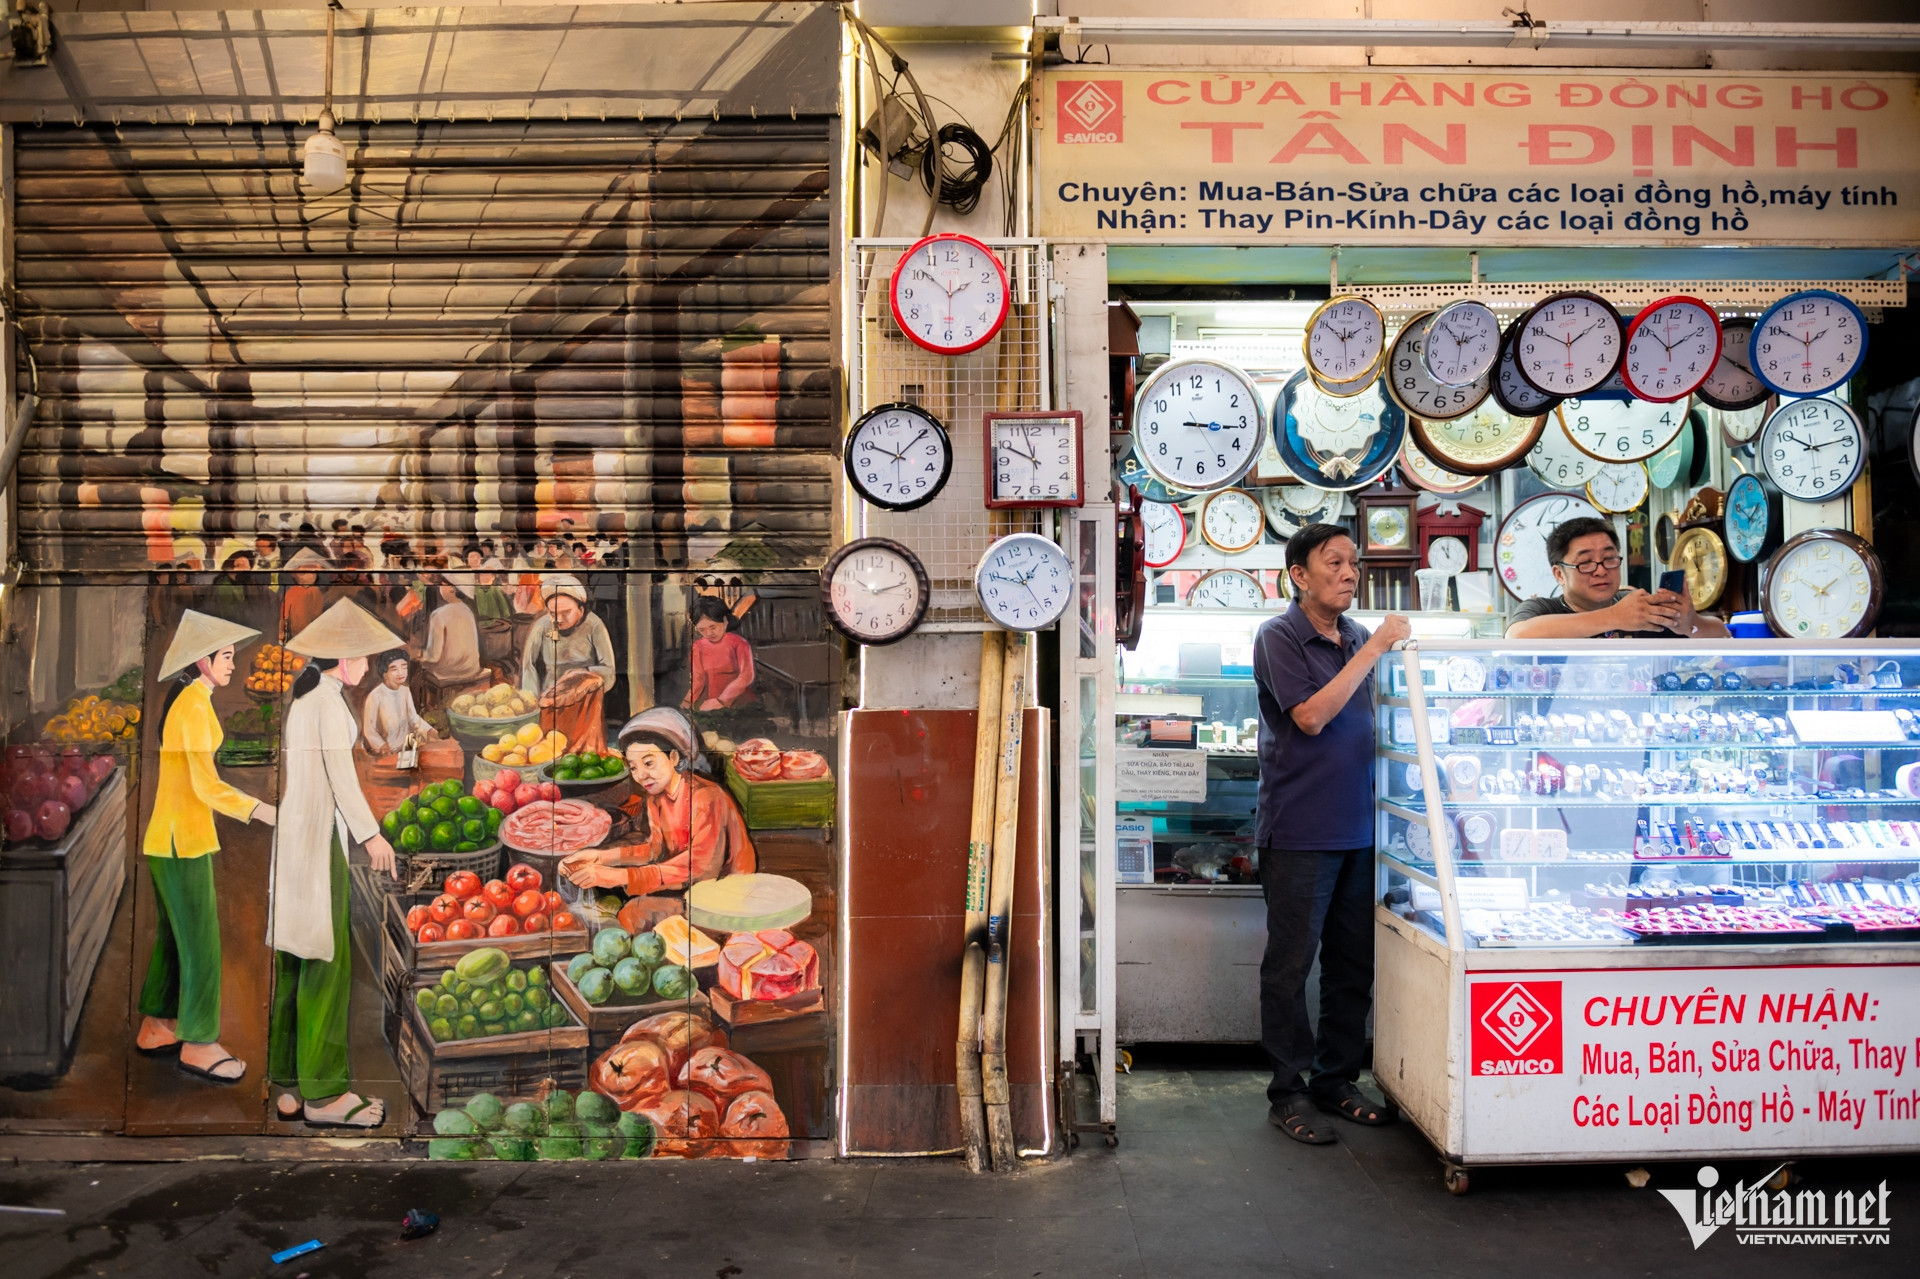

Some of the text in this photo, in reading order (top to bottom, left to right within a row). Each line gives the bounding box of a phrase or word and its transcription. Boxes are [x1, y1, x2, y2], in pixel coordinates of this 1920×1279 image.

[1146, 74, 1888, 111] CỬA HÀNG ĐỒNG HỒ
[1064, 132, 1116, 143] SAVICO
[1180, 110, 1857, 177] TÂN ĐỊNH
[1058, 182, 1187, 206] Chuyên:
[1199, 181, 1409, 202] Mua-Bán-Sửa
[1420, 182, 1497, 202] chữa
[1508, 183, 1560, 202] các
[1571, 183, 1624, 206] loại
[1635, 180, 1711, 208] đồng
[1841, 186, 1898, 206] tính
[1097, 207, 1749, 235] Nhận: Thay Pin-Kính-Dây các loại đồng hồ
[946, 251, 959, 262] 12
[969, 258, 974, 268] 1
[912, 270, 924, 280] 10
[982, 272, 990, 283] 2
[905, 288, 913, 299] 9
[987, 293, 995, 303] 3
[911, 308, 919, 319] 8
[1561, 304, 1575, 314] 12
[1584, 307, 1589, 316] 1
[1801, 304, 1815, 314] 12
[1825, 307, 1830, 316] 1
[979, 312, 987, 322] 4
[1544, 311, 1554, 321] 11
[1783, 311, 1793, 321] 11
[1598, 318, 1605, 328] 2
[1838, 317, 1846, 327] 2
[925, 324, 932, 334] 7
[964, 326, 972, 337] 5
[944, 330, 952, 340] 6
[1604, 335, 1611, 345] 3
[1844, 334, 1852, 344] 3
[1527, 344, 1534, 354] 9
[1763, 344, 1771, 353] 9
[1597, 354, 1605, 363] 4
[1837, 353, 1845, 362] 4
[1399, 359, 1411, 371] 9
[1533, 361, 1541, 370] 8
[1769, 360, 1777, 370] 8
[1547, 372, 1554, 381] 7
[1585, 368, 1592, 378] 5
[1784, 372, 1791, 381] 7
[1823, 367, 1830, 377] 5
[1190, 375, 1202, 388] 12
[1404, 378, 1416, 389] 8
[1566, 375, 1573, 384] 6
[1803, 374, 1811, 384] 6
[1170, 382, 1180, 396] 11
[1216, 380, 1220, 392] 1
[1231, 394, 1238, 408] 2
[1417, 391, 1429, 403] 7
[1434, 396, 1446, 408] 6
[1453, 391, 1465, 403] 5
[1154, 400, 1167, 413] 10
[1801, 407, 1818, 419] 12
[1824, 409, 1829, 419] 1
[885, 418, 899, 428] 12
[908, 420, 912, 428] 1
[1239, 416, 1246, 428] 3
[1578, 417, 1589, 431] 8
[1660, 412, 1671, 426] 4
[1788, 416, 1798, 427] 11
[872, 425, 881, 435] 11
[1151, 422, 1158, 434] 9
[1833, 420, 1845, 431] 2
[1011, 428, 1019, 436] 11
[1026, 427, 1041, 436] 12
[1052, 427, 1055, 435] 1
[1595, 433, 1606, 447] 7
[1642, 430, 1653, 444] 5
[999, 440, 1011, 449] 10
[1058, 439, 1069, 448] 2
[1160, 442, 1167, 455] 8
[1232, 438, 1240, 451] 4
[1617, 436, 1629, 451] 6
[926, 446, 937, 455] 3
[1775, 450, 1785, 460] 9
[860, 458, 870, 467] 9
[999, 457, 1009, 466] 9
[1059, 456, 1069, 464] 3
[1176, 457, 1182, 470] 7
[1218, 454, 1226, 467] 5
[1839, 455, 1850, 465] 4
[925, 463, 935, 472] 4
[1197, 462, 1204, 474] 6
[1782, 465, 1793, 476] 8
[868, 473, 877, 483] 8
[999, 474, 1010, 482] 8
[1059, 472, 1070, 480] 4
[1830, 469, 1840, 480] 5
[916, 477, 926, 487] 5
[1796, 476, 1806, 487] 7
[1813, 477, 1824, 488] 6
[883, 484, 892, 493] 7
[900, 485, 910, 494] 6
[1012, 486, 1021, 495] 7
[1030, 486, 1040, 494] 6
[1049, 485, 1059, 494] 5
[1584, 987, 1879, 1030] CHUYÊN NHẬN:
[1582, 1043, 1640, 1079] Mua,
[1649, 1041, 1703, 1078] Bán,
[1712, 1039, 1760, 1074] Sửa
[1769, 1039, 1840, 1076] Chữa,
[1849, 1038, 1907, 1077] Thay
[1481, 1058, 1554, 1074] SAVICO
[1573, 1095, 1619, 1127] Các
[1628, 1095, 1679, 1136] Loại
[1688, 1086, 1752, 1132] Đồng
[1762, 1085, 1794, 1123] Hồ
[1818, 1088, 1866, 1129] Máy
